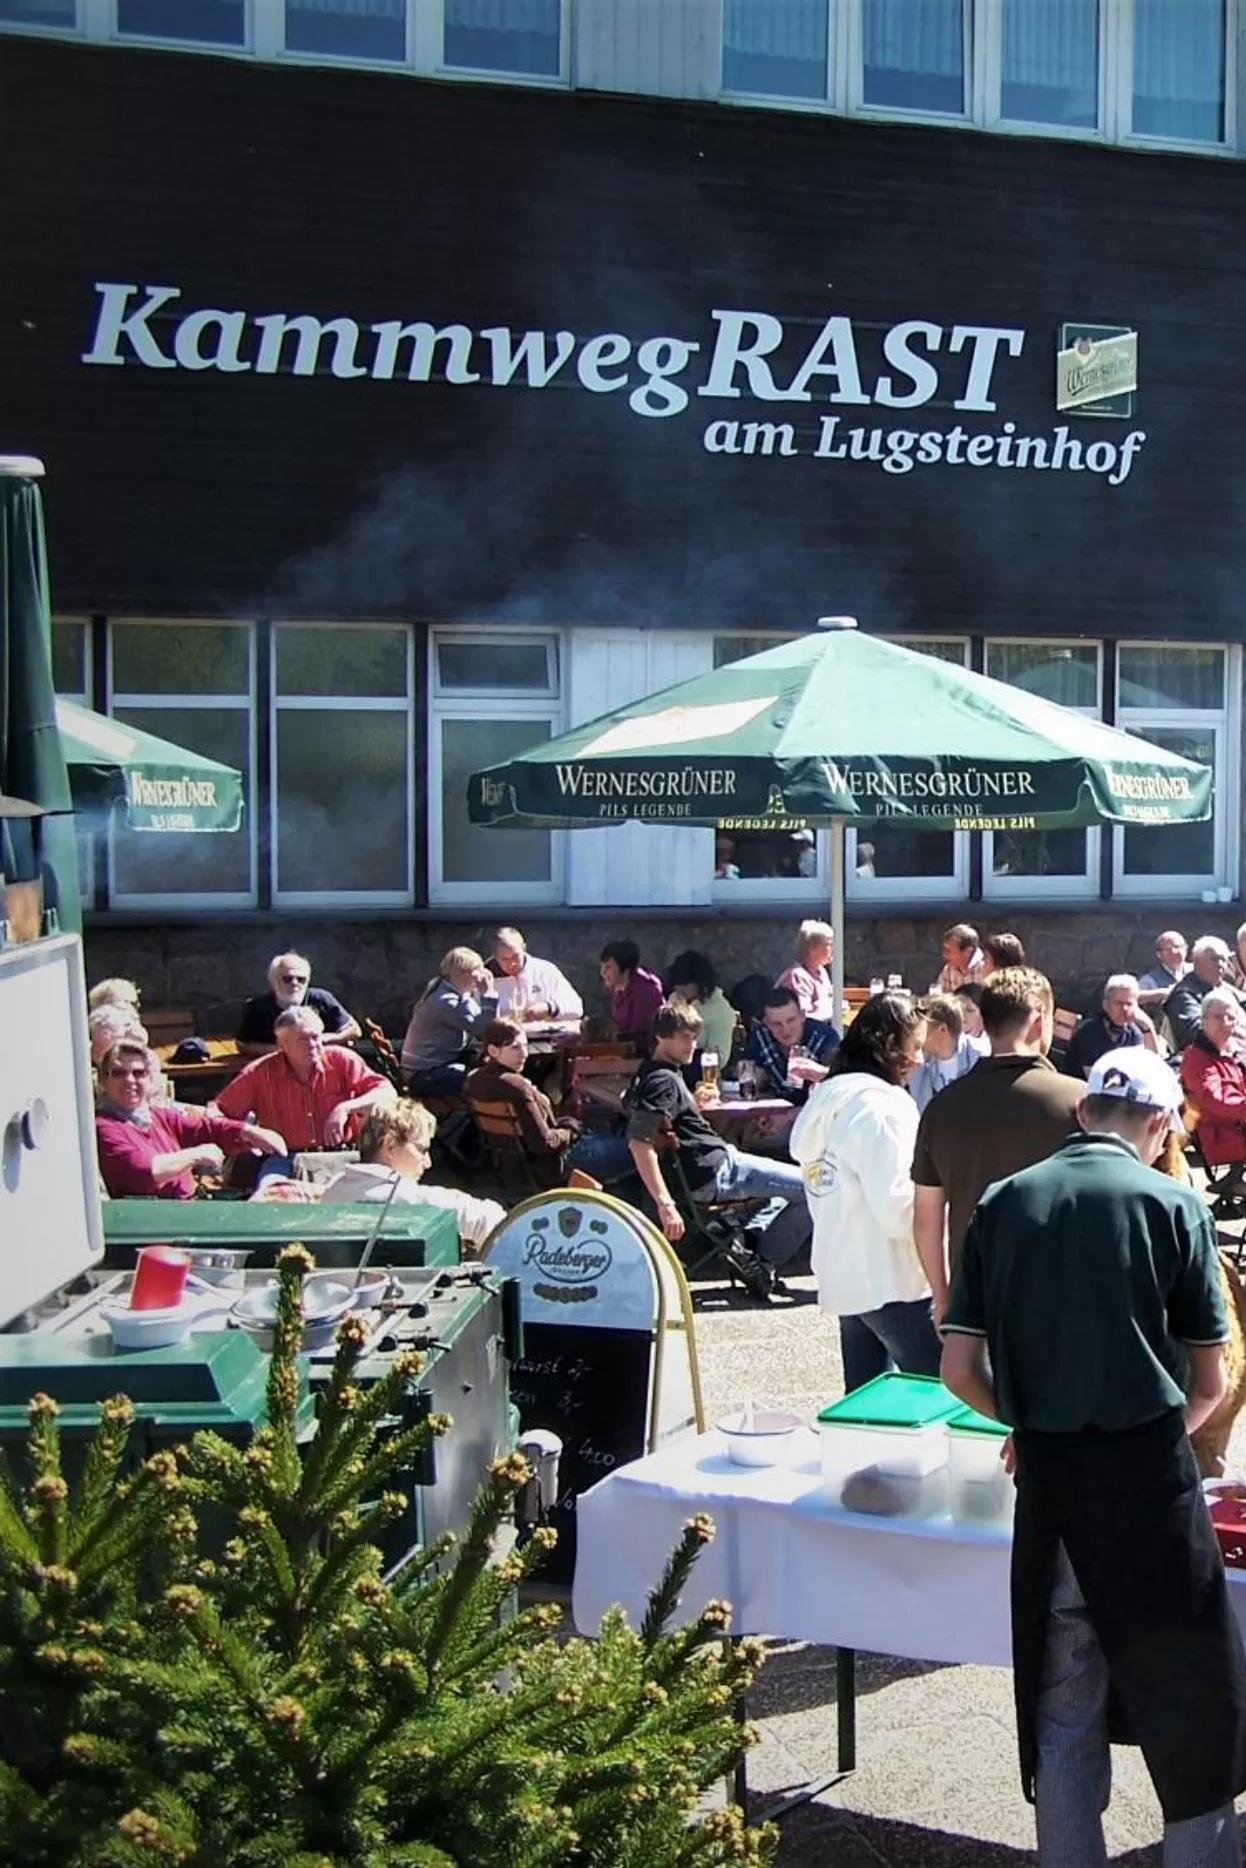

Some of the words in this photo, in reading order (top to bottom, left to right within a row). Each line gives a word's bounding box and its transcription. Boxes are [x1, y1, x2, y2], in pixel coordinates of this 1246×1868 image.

[704, 420, 798, 456] am
[813, 416, 1146, 484] Lugsteinhof
[555, 764, 737, 797] WERNESGRÜNER
[821, 763, 1036, 797] WERNESGRÜNER
[600, 803, 628, 817] PILS
[633, 803, 692, 817] LEGENDE
[913, 803, 983, 816] LEGENDE
